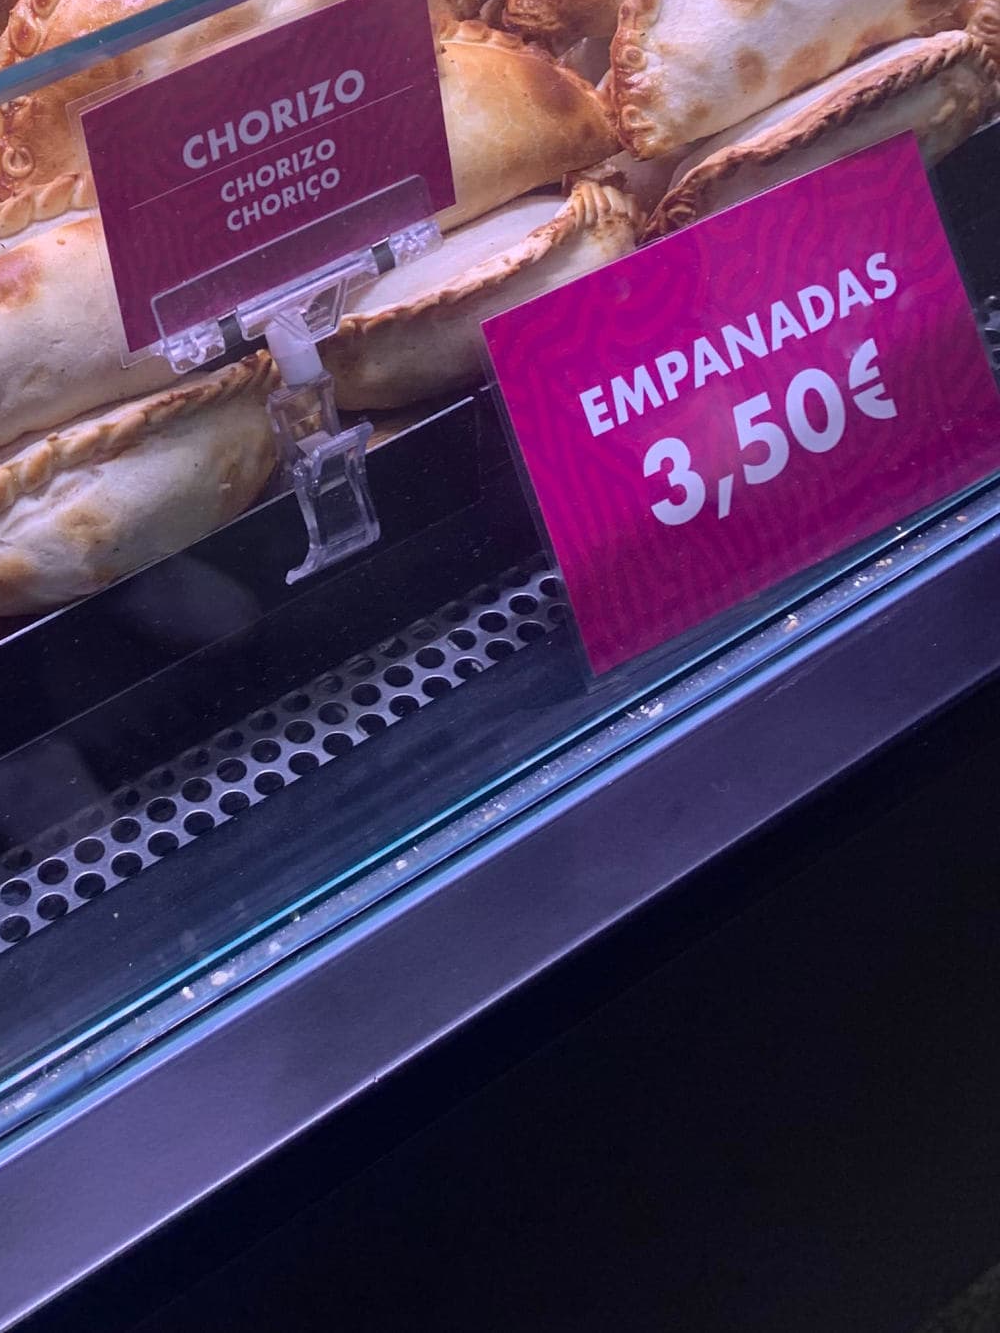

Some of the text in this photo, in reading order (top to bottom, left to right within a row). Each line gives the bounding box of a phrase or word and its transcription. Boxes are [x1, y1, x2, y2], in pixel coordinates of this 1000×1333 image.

[182, 69, 366, 169] CHORIZO
[220, 138, 336, 203] CHORIZO
[226, 167, 340, 231] CHORIÇO
[578, 251, 898, 437] EMPANADAS
[643, 337, 898, 526] 3,50€
